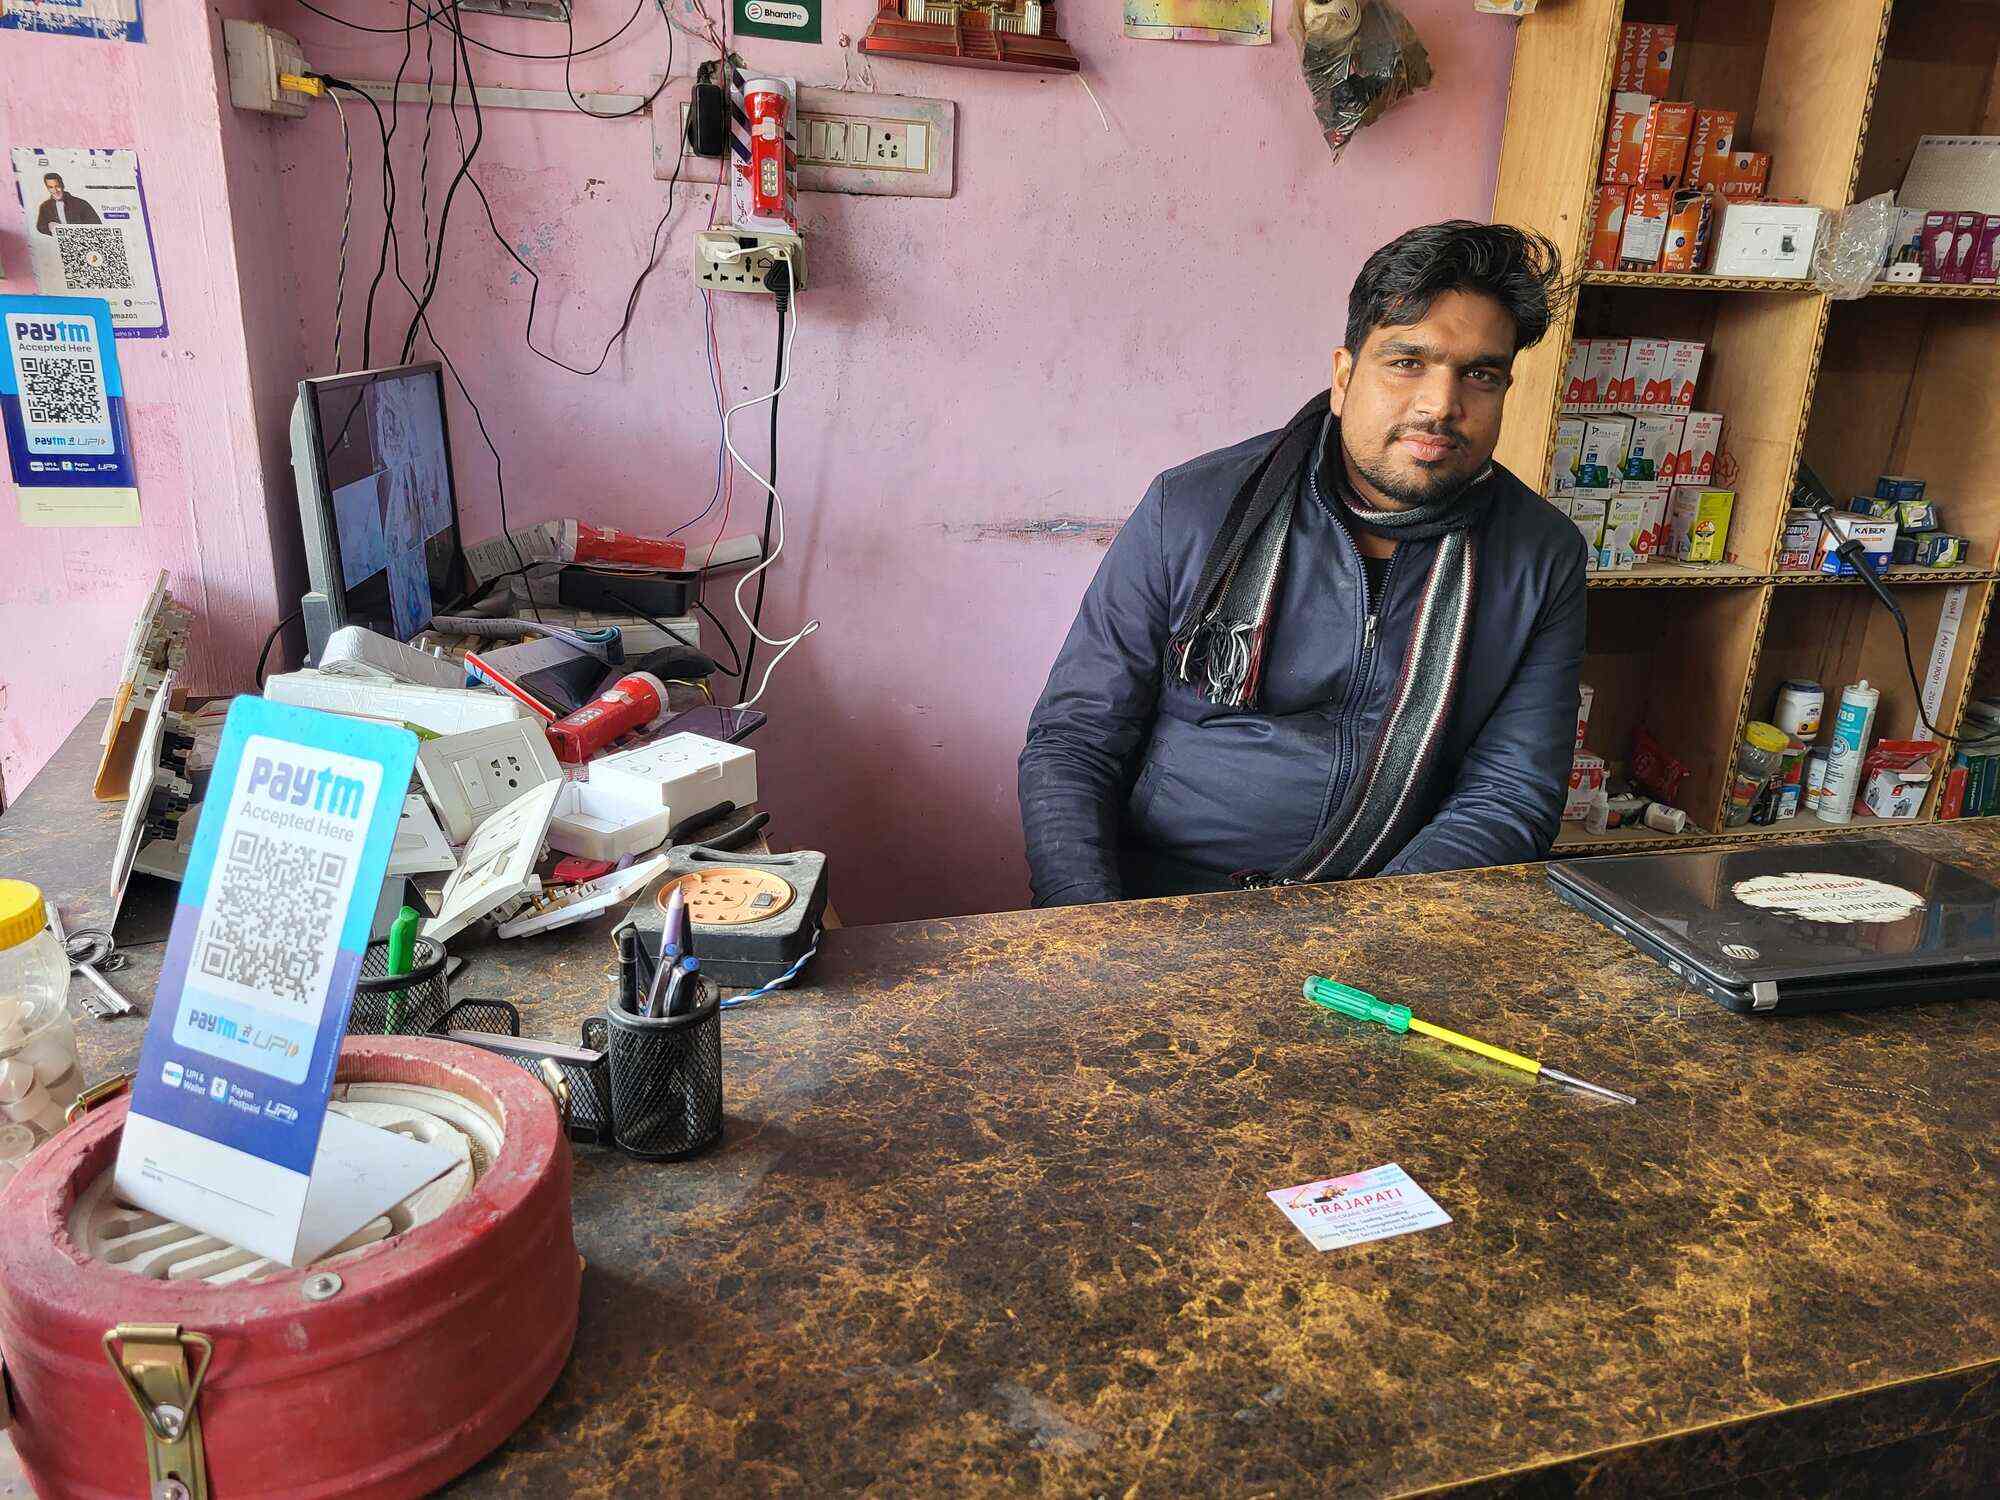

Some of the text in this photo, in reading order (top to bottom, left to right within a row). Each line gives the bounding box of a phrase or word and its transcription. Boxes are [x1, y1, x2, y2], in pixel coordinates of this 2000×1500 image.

[764, 8, 802, 20] BharatPe
[1616, 25, 1637, 92] HALONI
[1604, 100, 1625, 182] HALONI
[18, 343, 92, 353] Accepted Here
[240, 800, 354, 843] Accepted Here
[1308, 1188, 1403, 1217] PRAJAPATI
